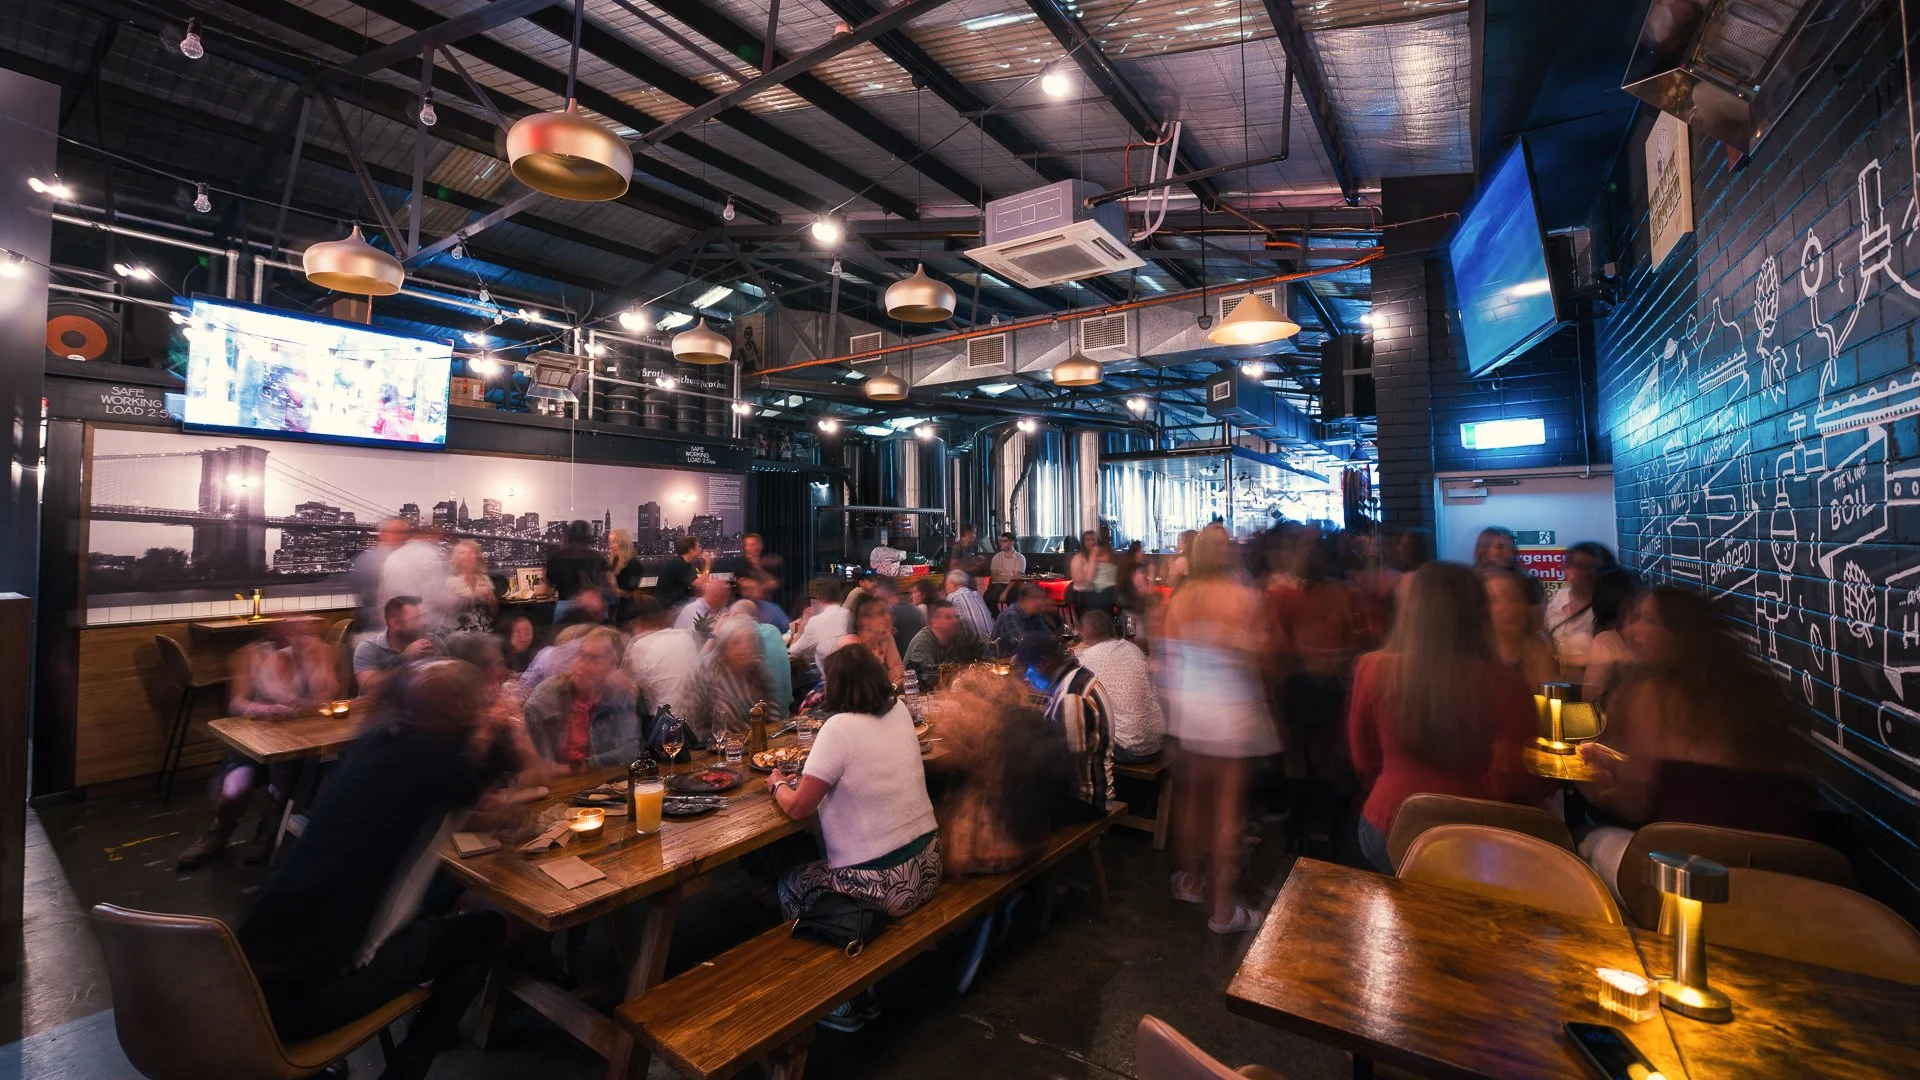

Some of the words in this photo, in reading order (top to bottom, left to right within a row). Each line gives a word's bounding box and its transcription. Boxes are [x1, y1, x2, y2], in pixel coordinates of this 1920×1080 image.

[111, 386, 144, 397] SAFE
[101, 395, 162, 408] WORKING
[106, 405, 143, 415] LOAD
[686, 451, 709, 459] WORKING
[1831, 484, 1876, 530] BOIL
[1711, 540, 1751, 584] SPARGED
[1528, 567, 1565, 580] Only
